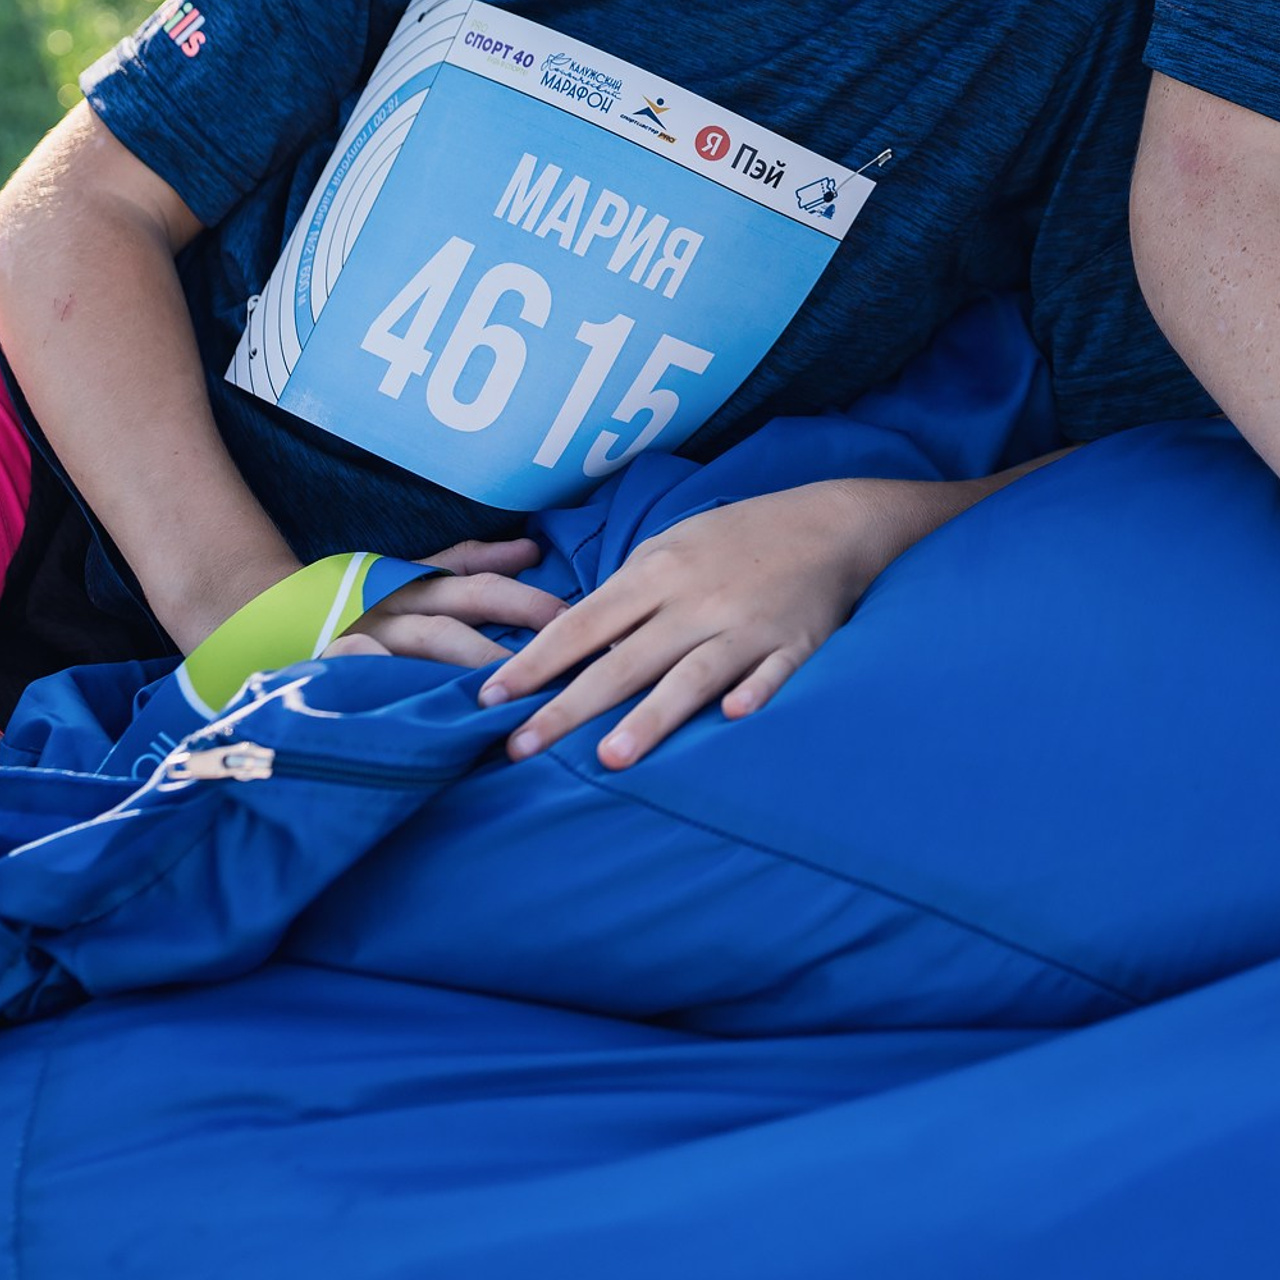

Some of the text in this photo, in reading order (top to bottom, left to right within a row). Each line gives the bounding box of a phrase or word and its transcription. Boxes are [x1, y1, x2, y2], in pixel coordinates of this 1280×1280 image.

[464, 30, 514, 60] СПОРТ
[513, 50, 535, 68] 40
[540, 70, 614, 114] МАРАФОН
[700, 130, 786, 189] Я Пэй
[493, 152, 705, 299] МАРИЯ
[360, 235, 715, 478] 4615
